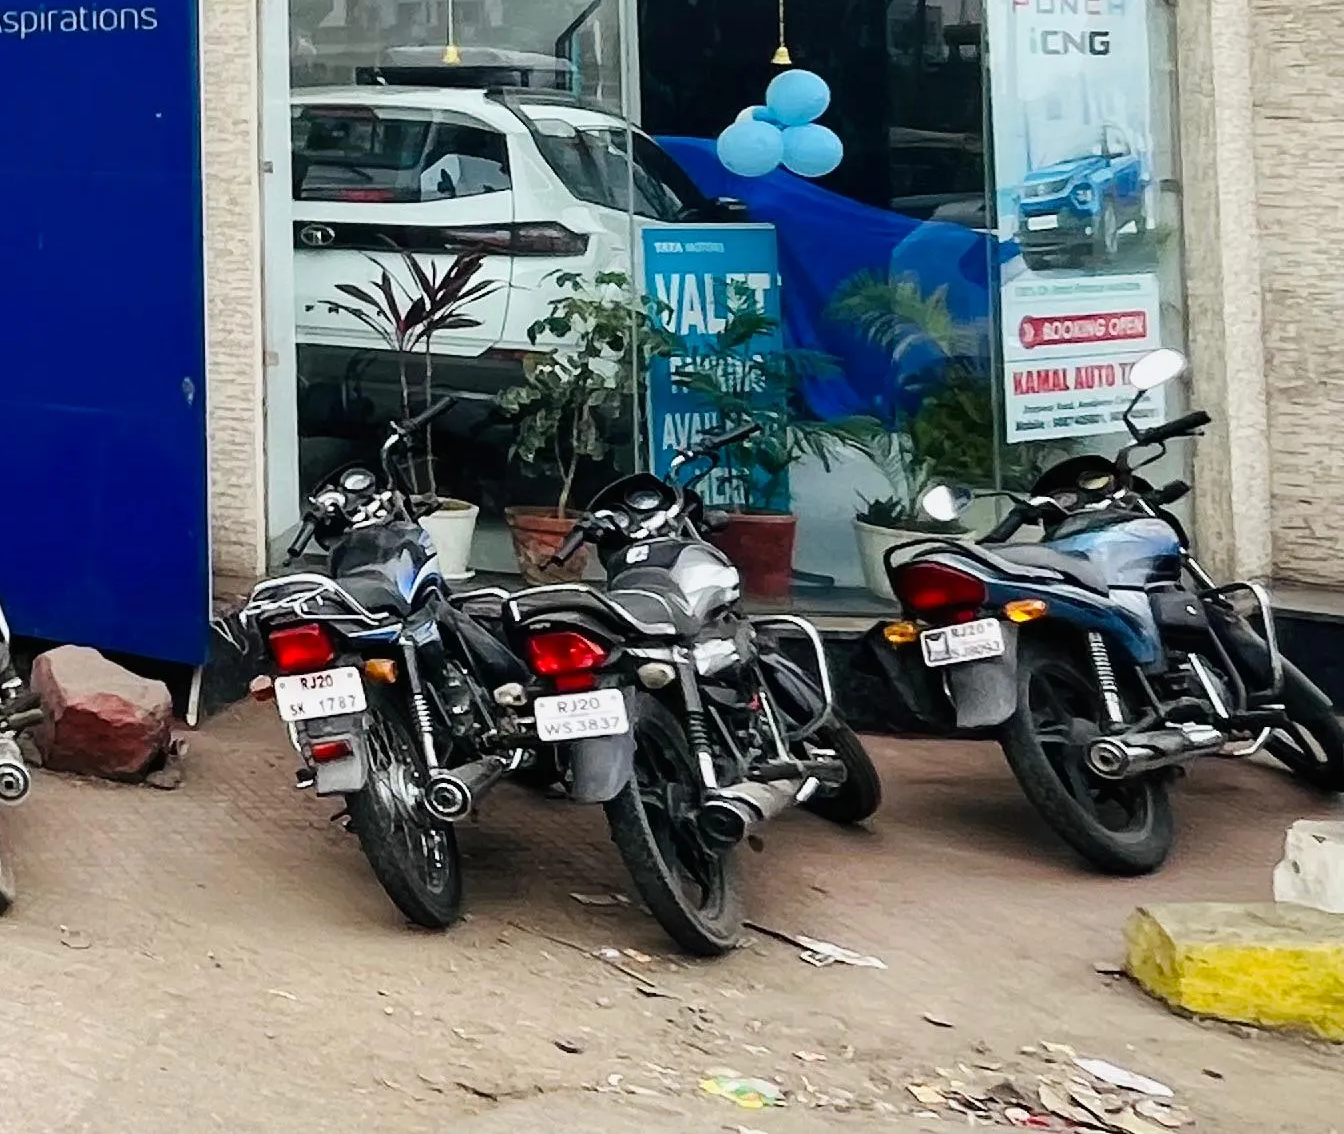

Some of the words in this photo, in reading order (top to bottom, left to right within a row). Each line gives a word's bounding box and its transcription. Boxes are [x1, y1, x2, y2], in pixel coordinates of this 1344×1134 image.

[1042, 319, 1106, 341] BOOKING
[1108, 315, 1145, 337] OPEN
[1013, 368, 1070, 396] KAMAL
[1074, 364, 1117, 390] AUTO
[300, 674, 334, 691] RJ20
[318, 694, 356, 714] 1787
[556, 697, 600, 714] RJ20
